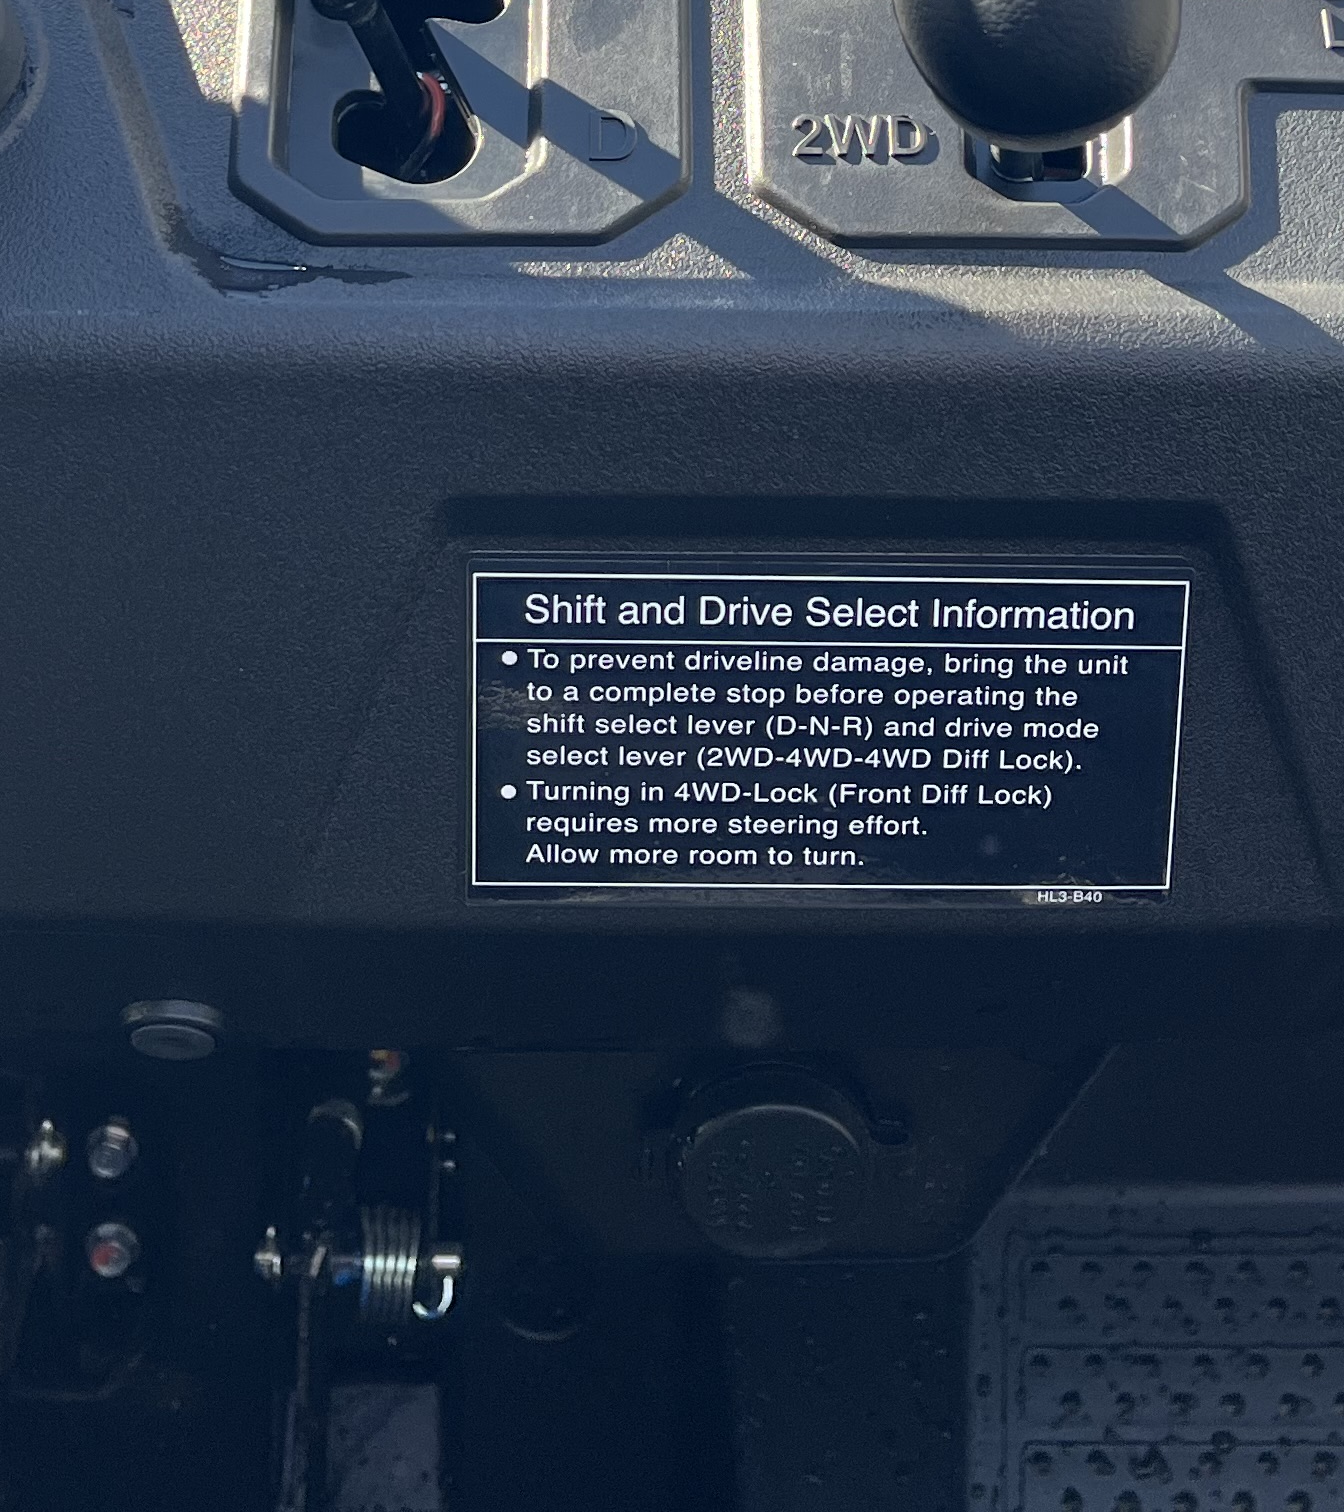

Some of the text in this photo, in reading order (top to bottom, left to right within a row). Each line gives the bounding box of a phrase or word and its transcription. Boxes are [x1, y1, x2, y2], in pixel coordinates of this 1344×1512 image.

[589, 109, 638, 161] D
[792, 114, 929, 158] 2WD
[524, 593, 1135, 630] Shift and Drive Select Information
[526, 648, 1129, 678] To prevent driveline damage, bring the unit
[526, 682, 1078, 711] to a complete stop before operating the
[526, 713, 1099, 741] shift select lever (D-N-R) and drive mode
[526, 745, 1082, 774] select lever (2WD-4WD-4WD Diff Lock).
[525, 781, 1052, 809] Turning in 4WD-Lock (Front Diff Lock)
[526, 812, 927, 839] requires more steering effort.
[525, 843, 864, 866] Allow more room to turn.
[1037, 890, 1103, 903] HL3-B40
